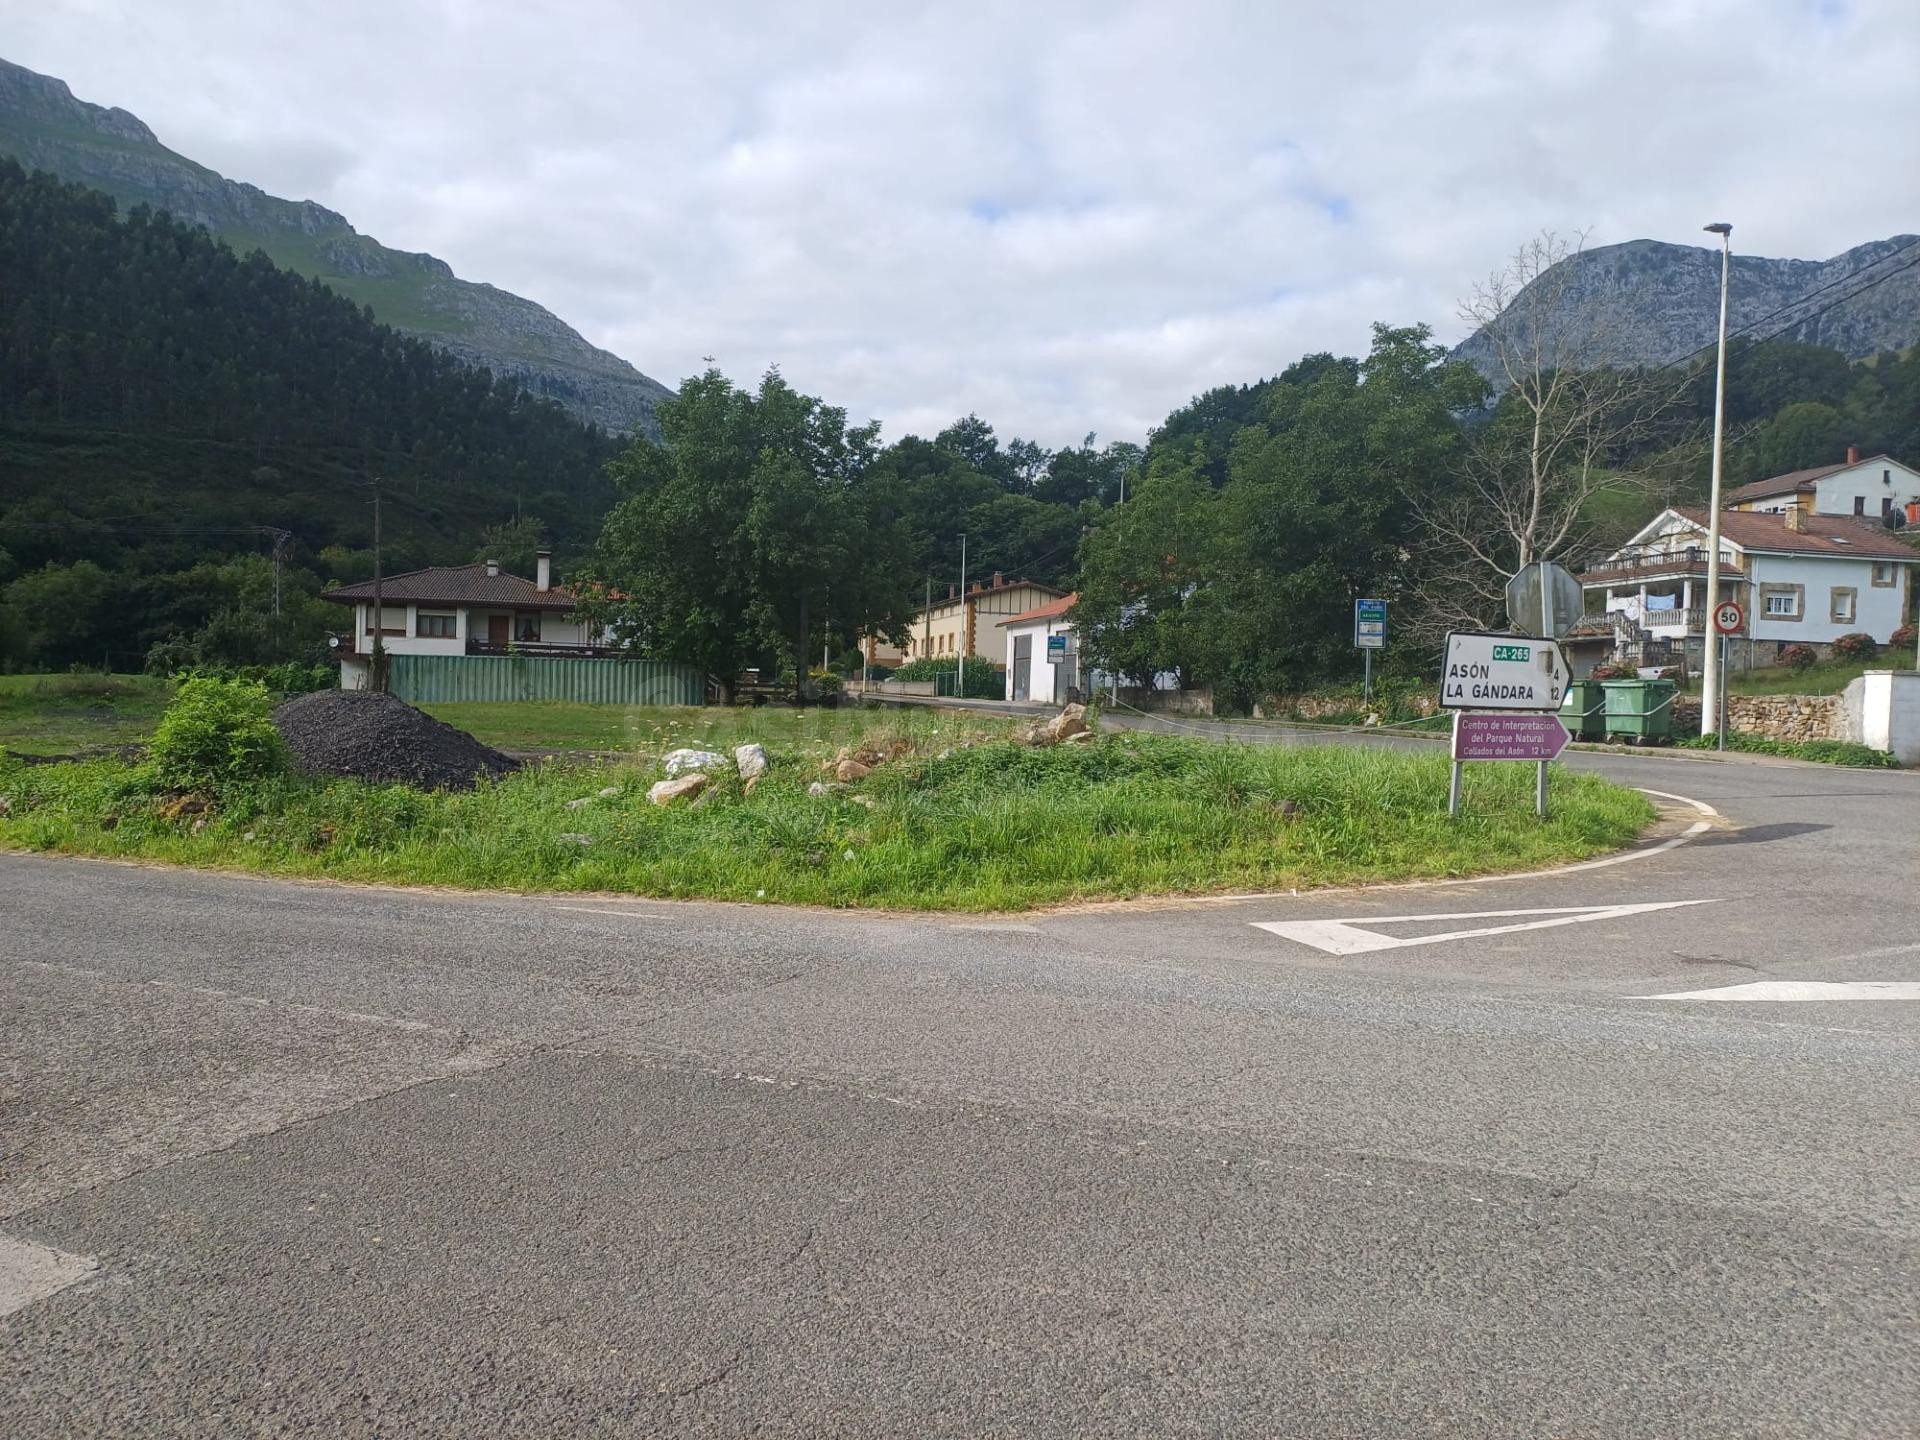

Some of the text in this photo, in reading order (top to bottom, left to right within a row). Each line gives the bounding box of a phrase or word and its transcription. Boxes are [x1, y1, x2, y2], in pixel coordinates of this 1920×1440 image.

[1721, 612, 1737, 623] 50
[1494, 647, 1530, 660] CA-265
[1449, 661, 1560, 681] ASÓN 4
[1446, 682, 1559, 700] LA GÁNDARA 12
[1462, 720, 1489, 730] Centro
[1490, 720, 1500, 730] de
[1471, 733, 1544, 744] del Parque Natural
[1463, 746, 1552, 756] Collados del Asón 12 km
